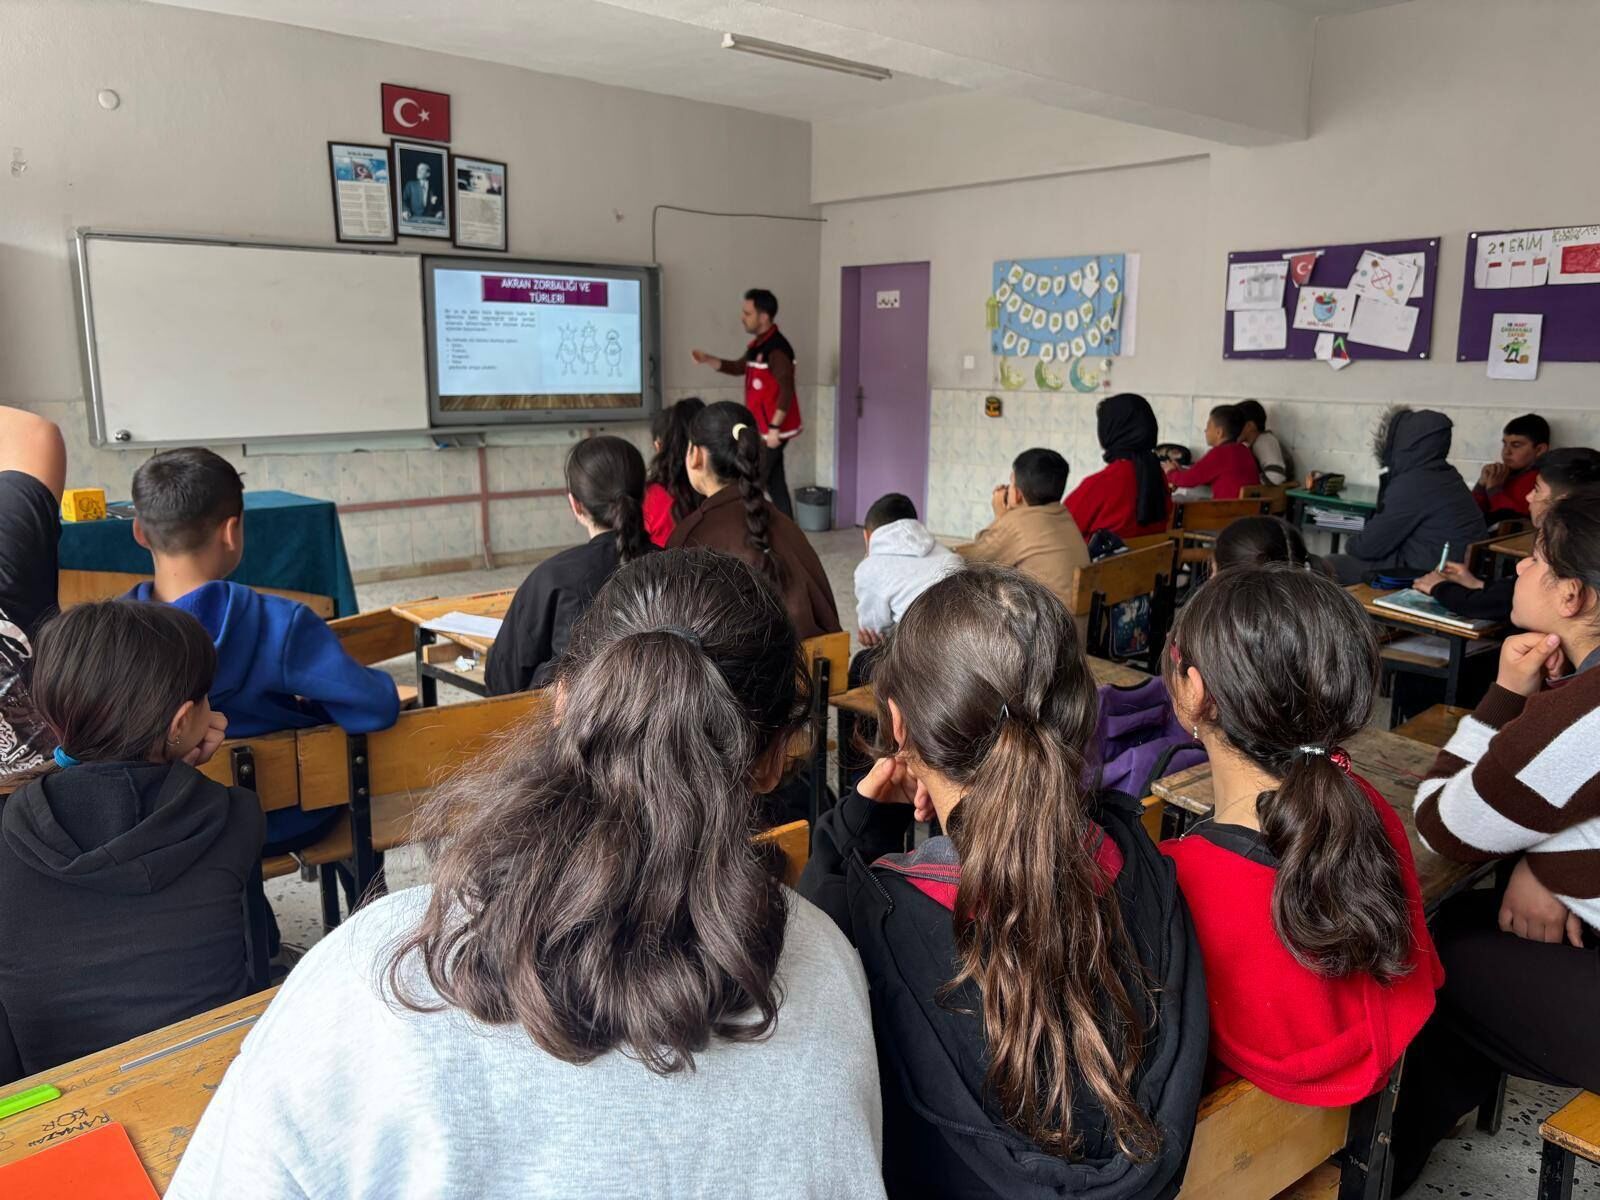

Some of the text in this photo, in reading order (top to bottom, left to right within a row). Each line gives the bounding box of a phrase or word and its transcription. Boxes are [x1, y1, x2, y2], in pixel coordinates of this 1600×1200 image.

[501, 278, 591, 293] AKRAN ZORBALIĞI VE
[529, 291, 565, 304] TÜRLERİ
